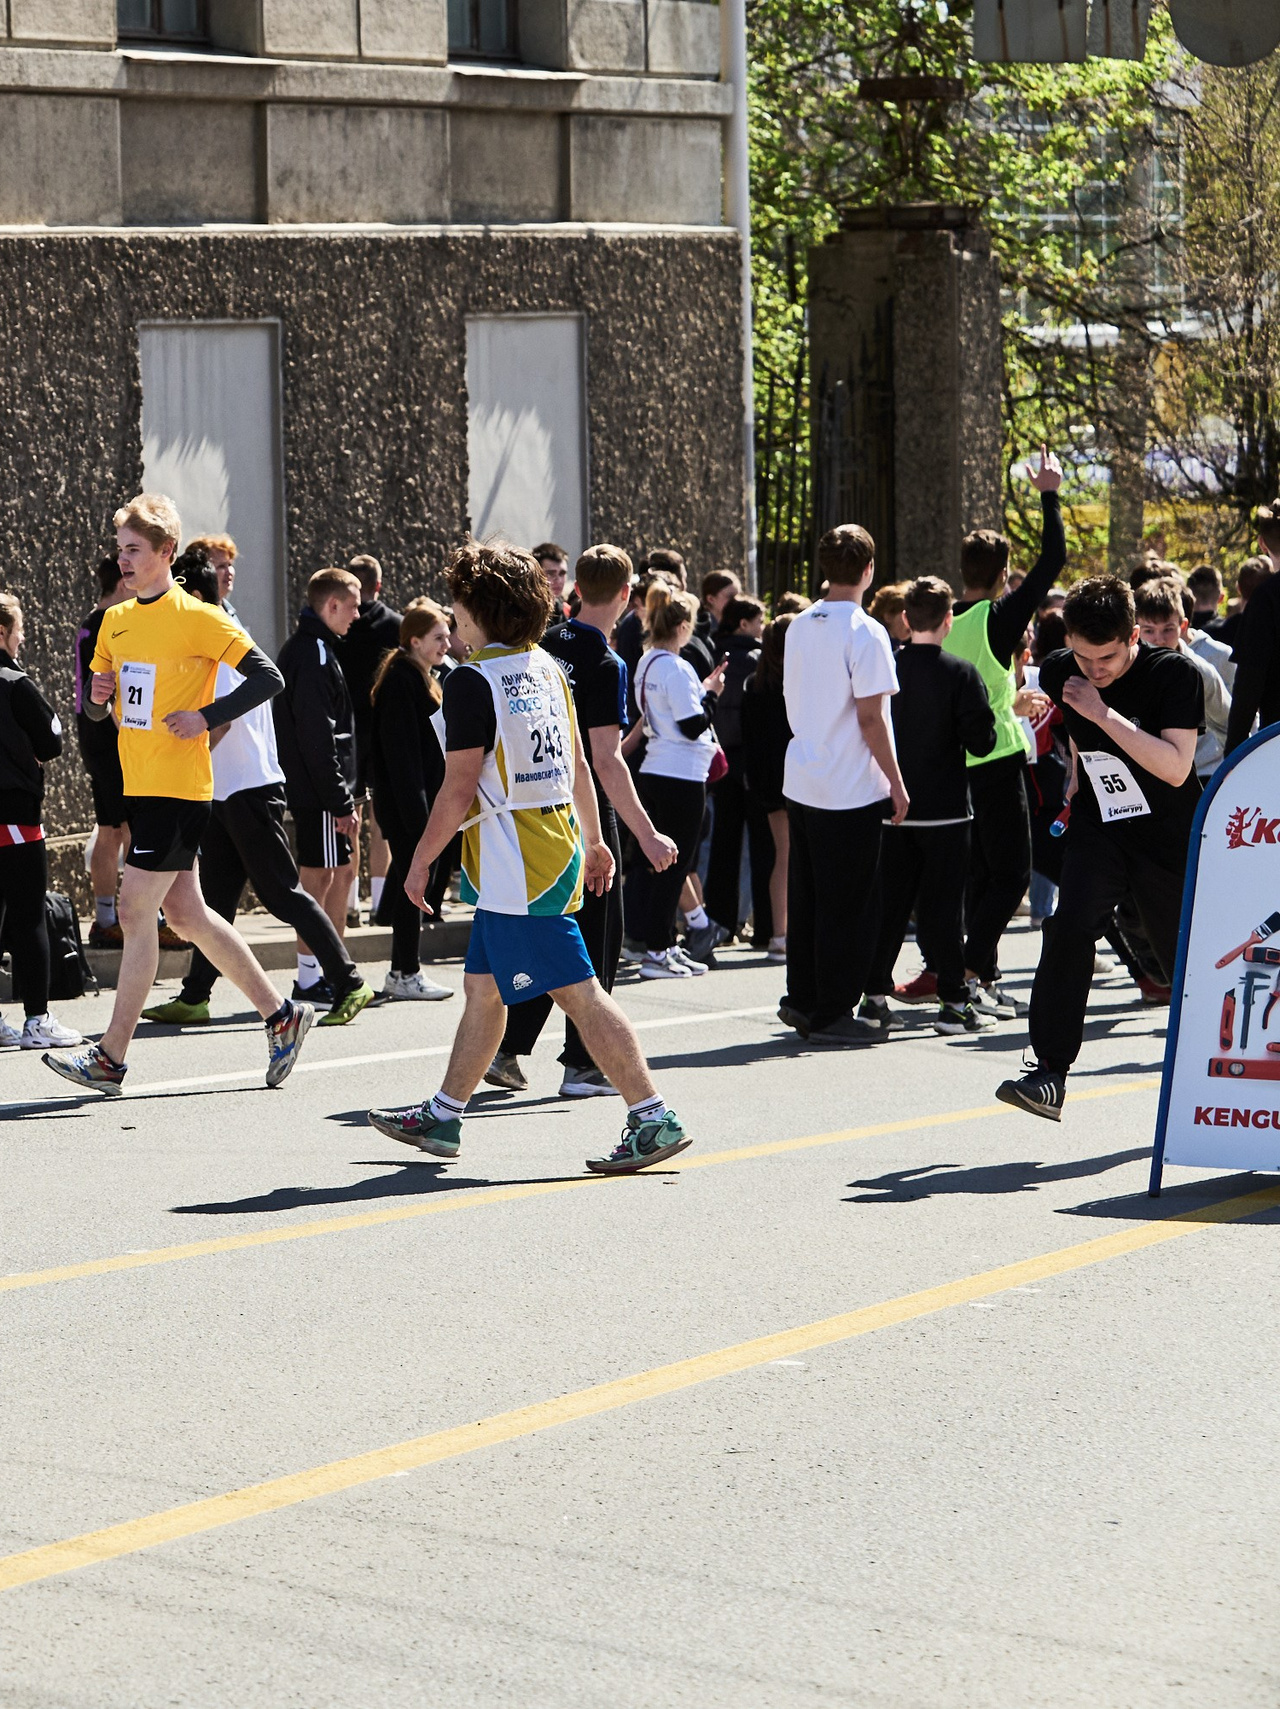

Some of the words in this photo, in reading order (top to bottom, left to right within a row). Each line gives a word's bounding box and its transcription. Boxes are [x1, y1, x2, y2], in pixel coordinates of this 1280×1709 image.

[128, 685, 143, 705] 21
[531, 725, 562, 764] 243
[1099, 773, 1127, 794] 55
